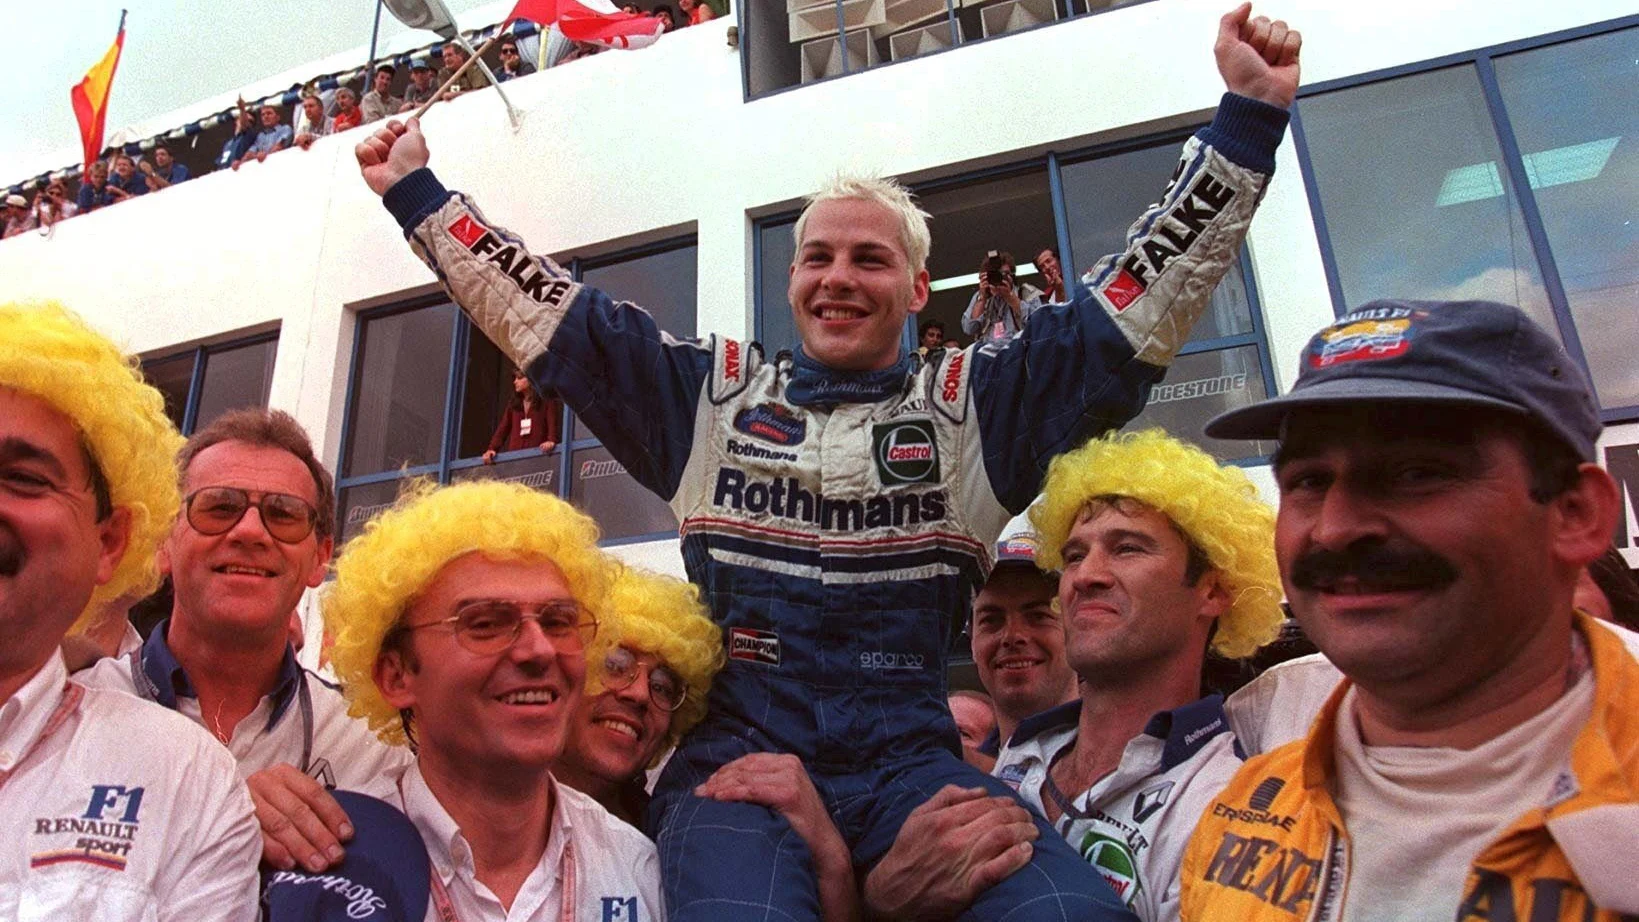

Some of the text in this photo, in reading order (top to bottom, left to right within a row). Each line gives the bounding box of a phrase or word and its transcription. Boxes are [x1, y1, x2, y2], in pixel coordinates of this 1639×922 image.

[1122, 172, 1236, 288] FALKE
[470, 231, 570, 307] FALKE
[943, 353, 966, 402] SONAX
[727, 439, 798, 462] Rothmans
[889, 445, 932, 459] Castrol
[714, 466, 946, 531] Rothmans
[735, 637, 778, 656] CHAMPION
[860, 651, 924, 670] sparco
[81, 785, 145, 823] F1
[36, 818, 138, 841] RENAULT
[75, 837, 132, 857] sport
[601, 896, 639, 922] F1
